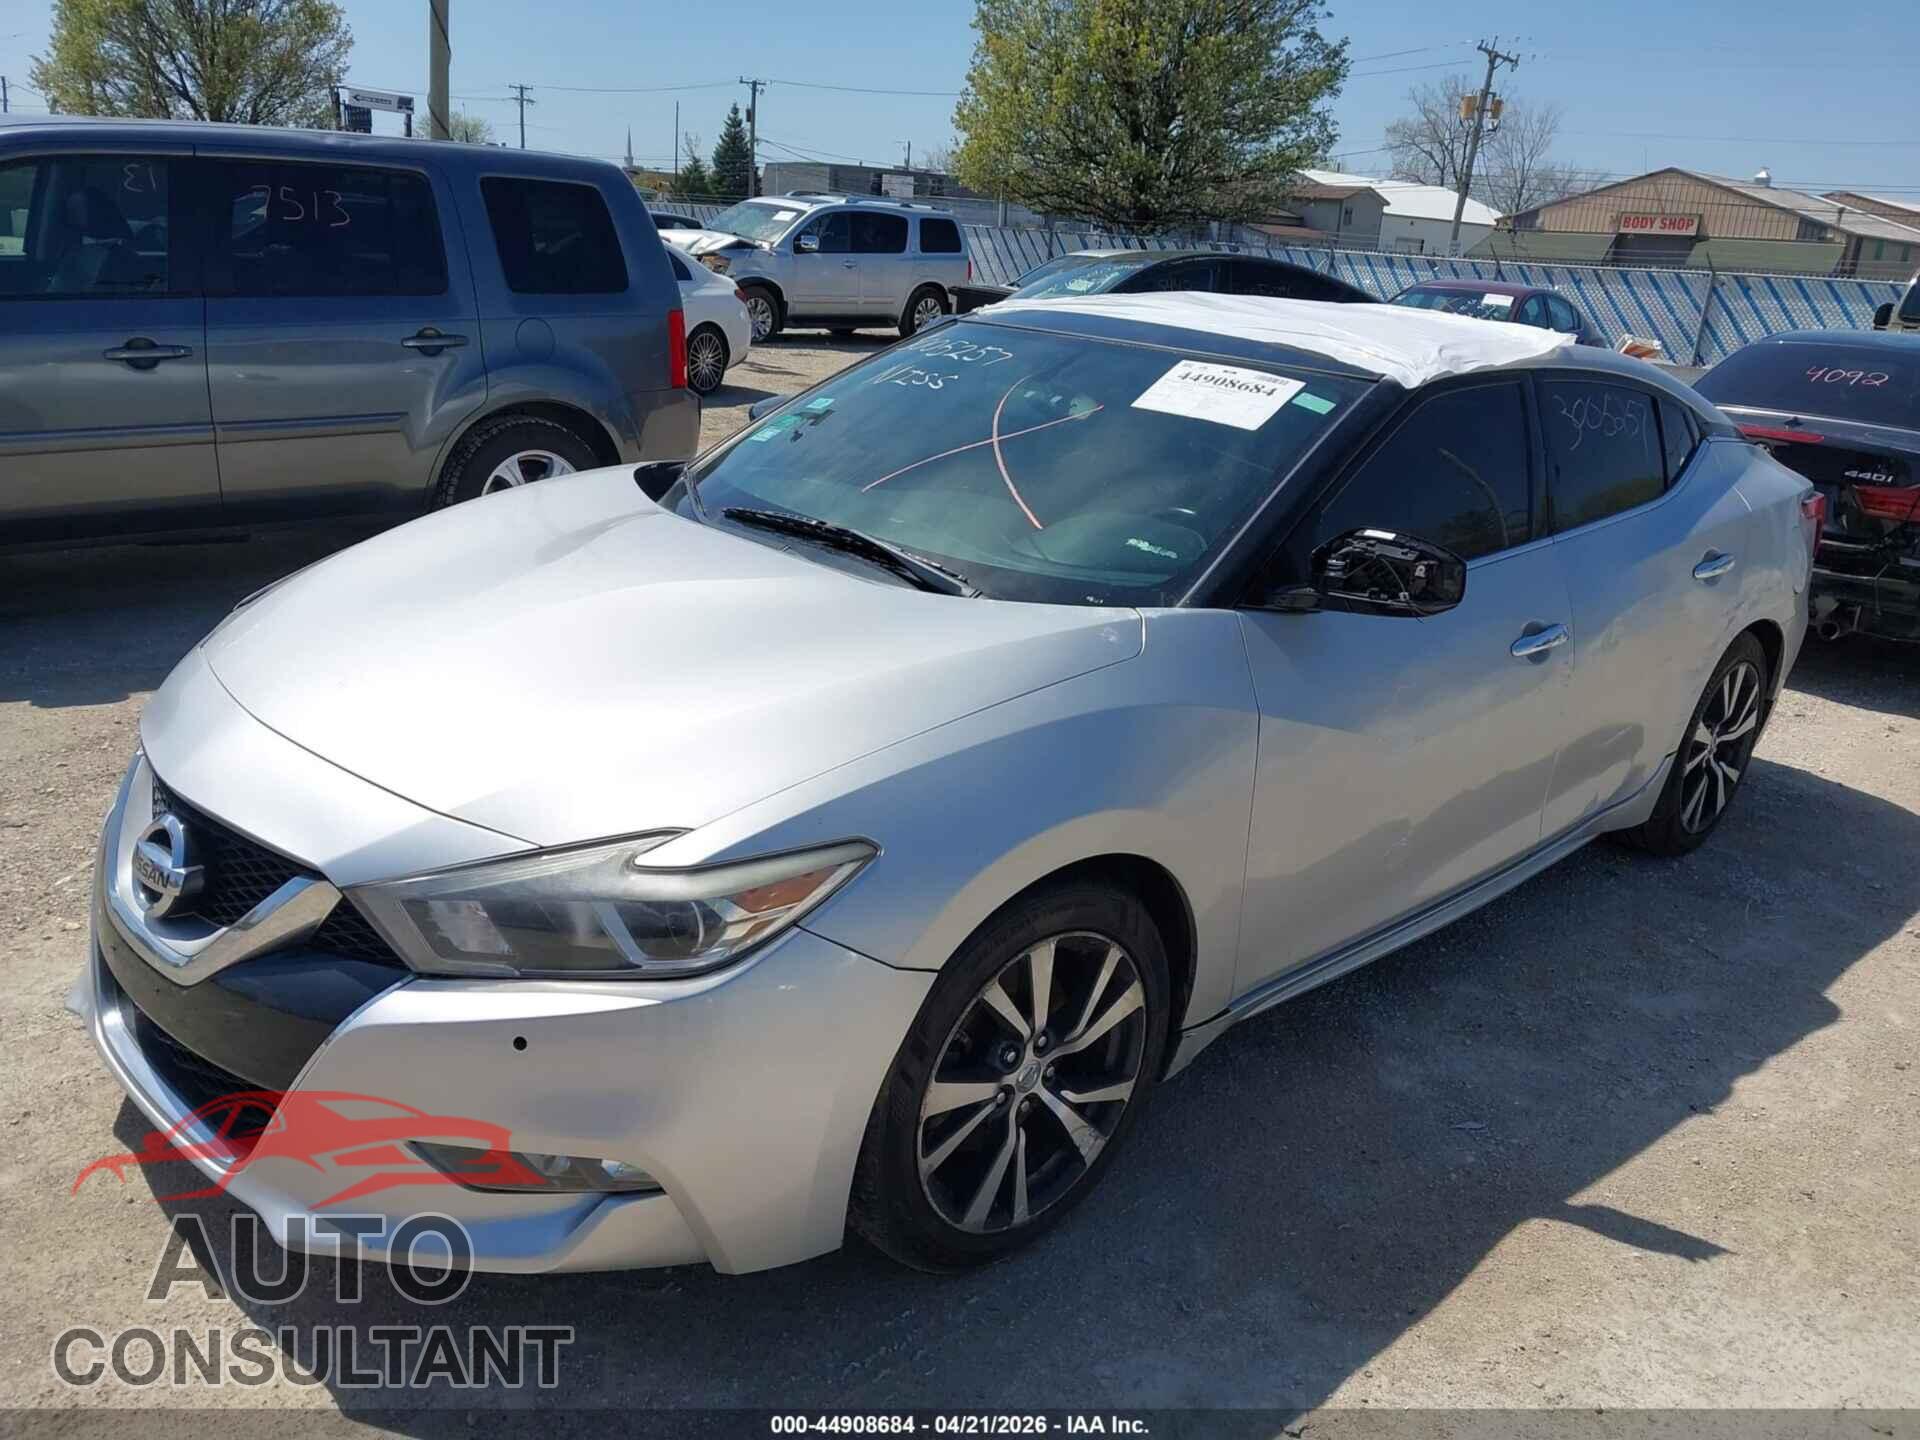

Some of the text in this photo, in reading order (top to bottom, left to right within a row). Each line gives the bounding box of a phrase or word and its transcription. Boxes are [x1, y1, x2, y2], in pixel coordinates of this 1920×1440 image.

[250, 184, 350, 227] 7513
[1622, 216, 1694, 230] BODY SHOP
[1177, 371, 1278, 397] 44908684
[1806, 366, 1889, 386] 4092
[132, 853, 171, 890] SSAN
